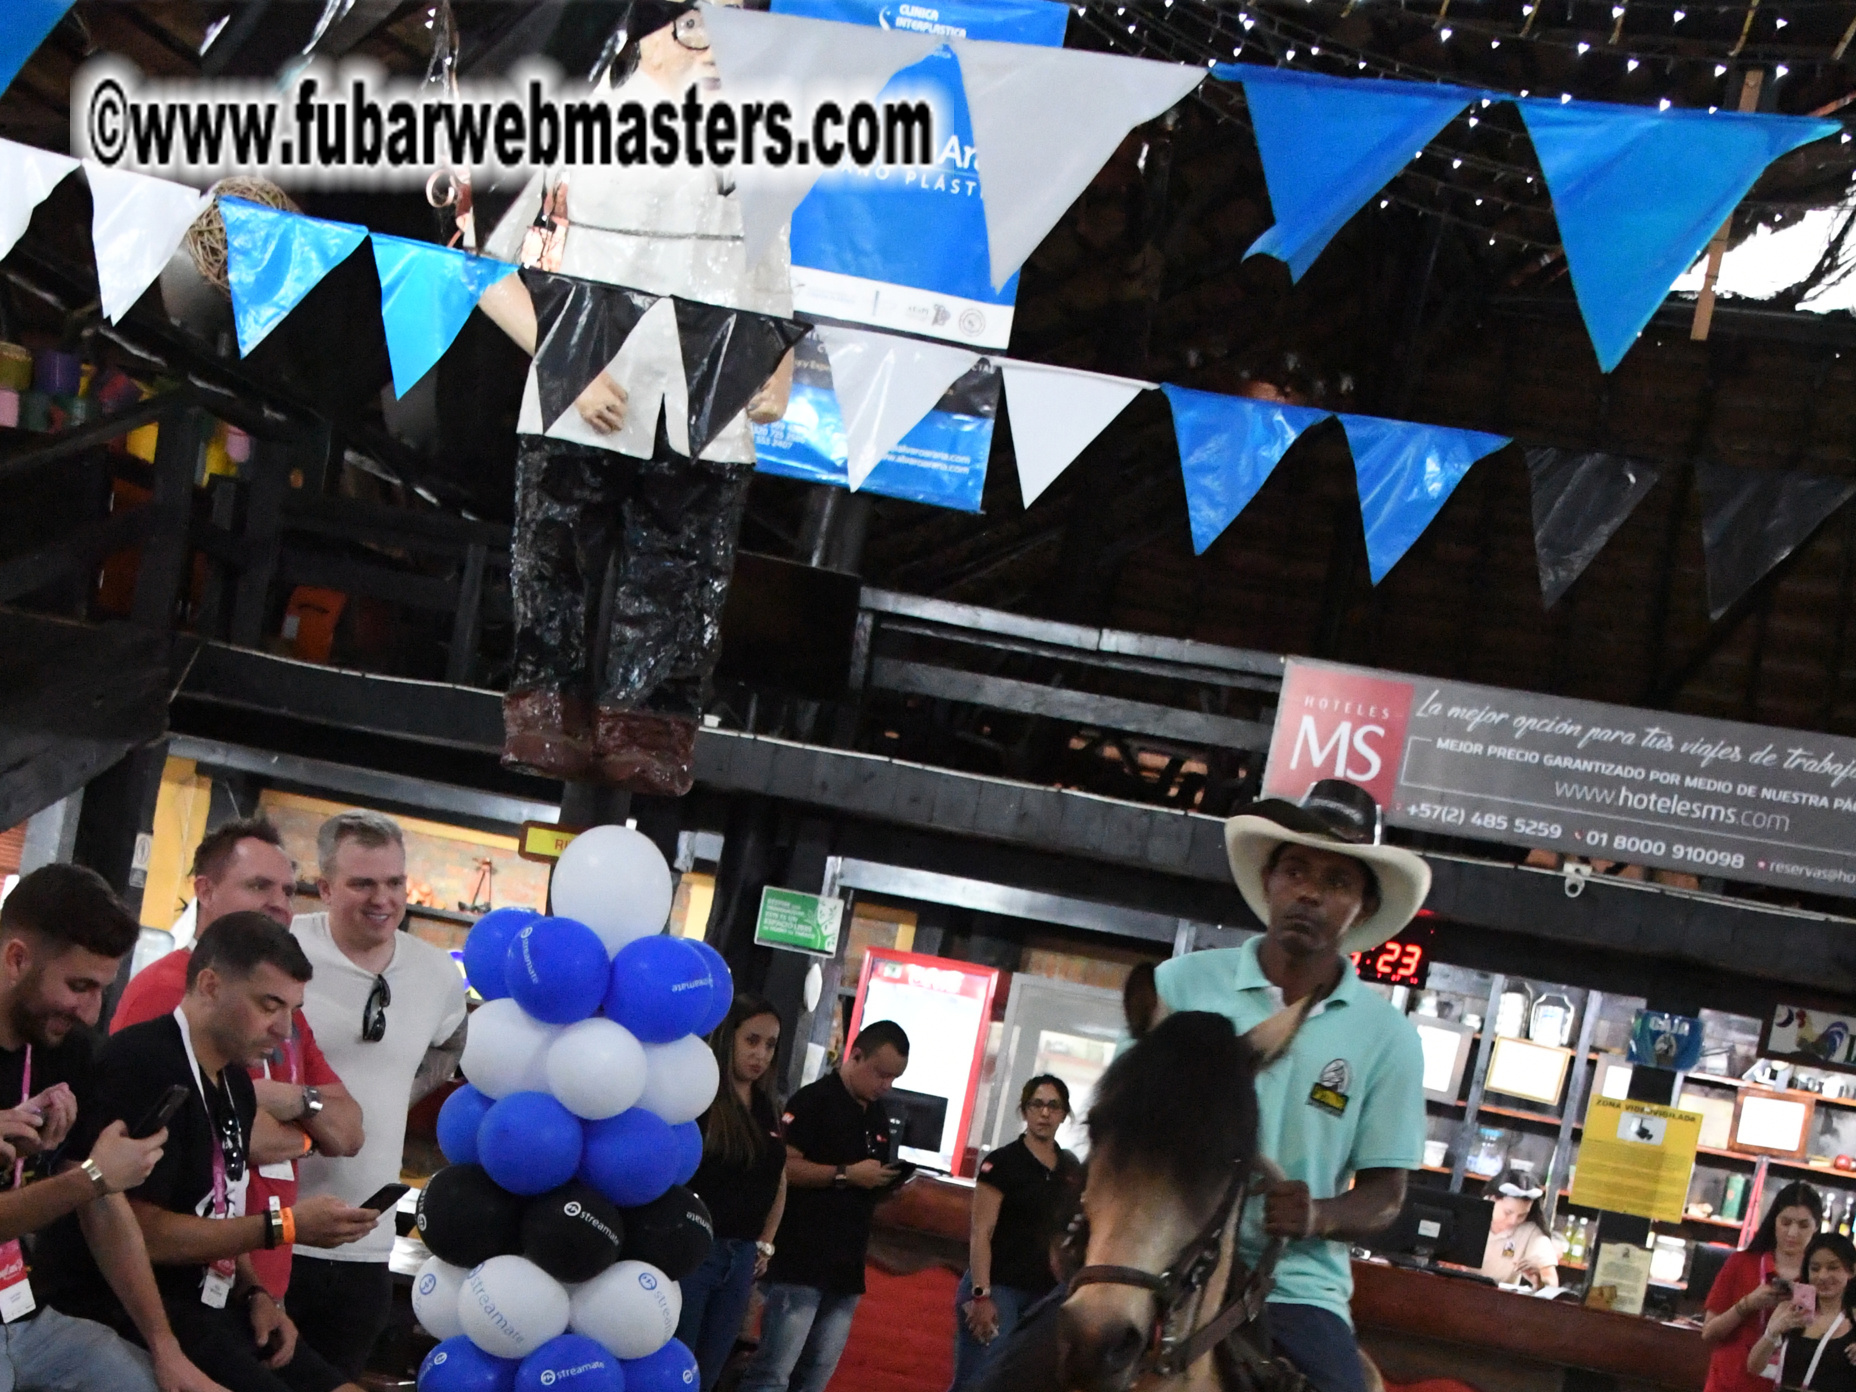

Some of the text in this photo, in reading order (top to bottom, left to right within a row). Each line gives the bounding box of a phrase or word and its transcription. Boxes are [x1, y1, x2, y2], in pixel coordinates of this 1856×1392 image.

[895, 16, 967, 39] INTERPLASTICA
[899, 4, 939, 22] CLINICA
[841, 158, 983, 200] ANO PLAST
[1303, 695, 1390, 719] HOTELES
[1290, 714, 1386, 782] MS
[1416, 689, 1443, 718] La
[1447, 705, 1509, 732] mejor
[1513, 716, 1582, 739] opción
[1577, 726, 1636, 749] para
[1641, 726, 1674, 752] tus
[1680, 737, 1742, 768] viajes
[1749, 744, 1778, 767] de
[1436, 736, 1484, 756] MEJOR
[1487, 745, 1540, 764] PRECIO
[1543, 754, 1646, 780] GARANTIZADO
[1649, 770, 1681, 786] POR
[1684, 775, 1733, 794] MEDIO
[1737, 784, 1757, 798] DE
[1761, 787, 1829, 809] NUESTRA
[1407, 803, 1563, 839] +57(2) 485 5259
[1555, 780, 1791, 832] www.hotelesms.com
[1586, 830, 1746, 869] 01 8000 910098
[522, 937, 539, 985] streamate
[1596, 1099, 1621, 1109] ZONA
[580, 1210, 620, 1246] streamate
[469, 1276, 525, 1345] streamate
[557, 1360, 605, 1380] streamate
